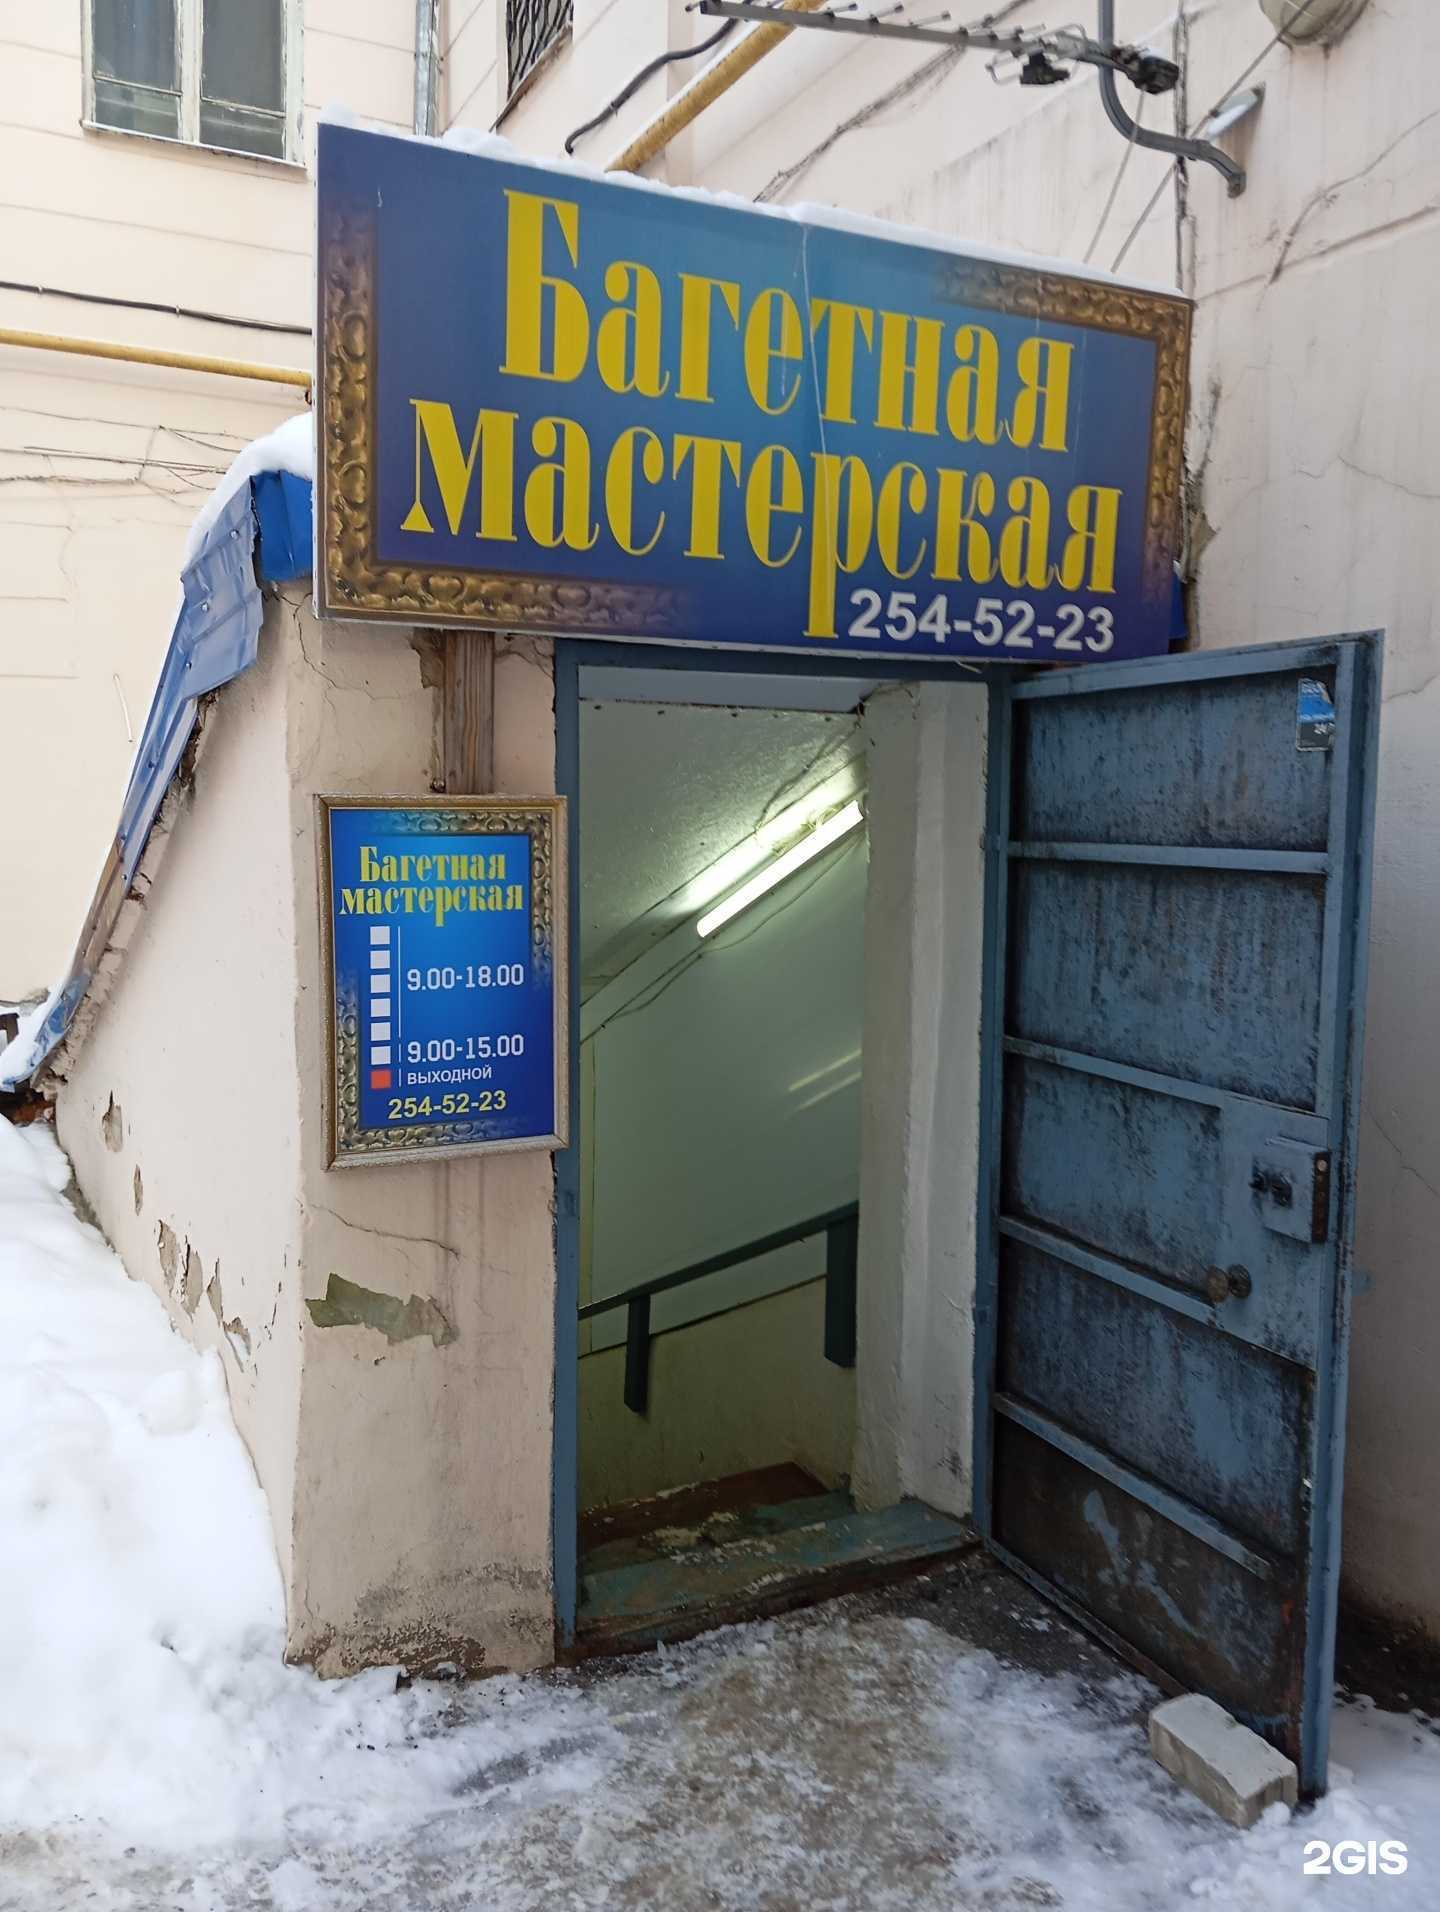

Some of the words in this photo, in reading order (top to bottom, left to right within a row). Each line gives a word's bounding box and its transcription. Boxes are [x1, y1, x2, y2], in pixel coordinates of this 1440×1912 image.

[499, 188, 1076, 453] Багетная
[401, 398, 1123, 639] мастерская
[849, 589, 1115, 653] 254-52-23
[360, 846, 506, 882] Багетная
[338, 884, 524, 927] мастерская
[407, 964, 524, 991] 9.00-18.00
[407, 1034, 524, 1063] 9.00-15.00
[388, 1090, 507, 1119] 254-52-23
